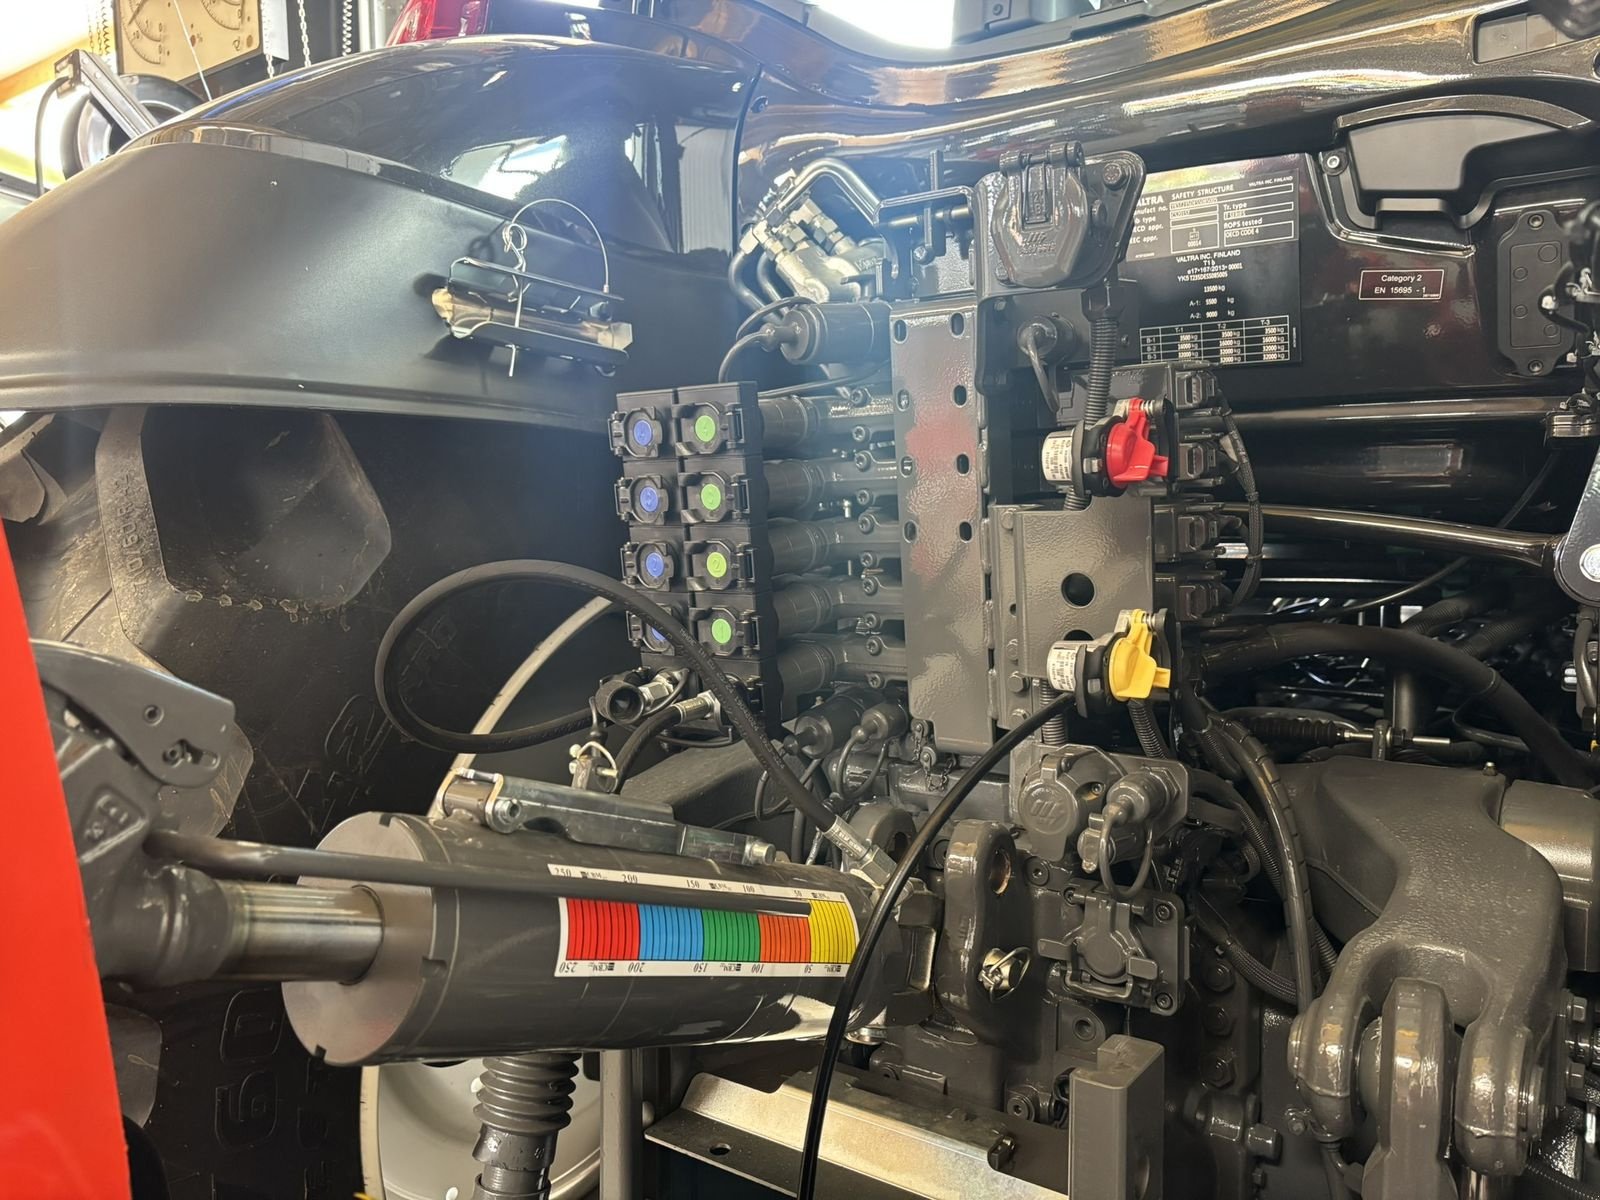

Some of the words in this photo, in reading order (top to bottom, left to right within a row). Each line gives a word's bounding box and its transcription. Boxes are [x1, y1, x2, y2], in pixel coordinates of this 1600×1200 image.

[1137, 195, 1164, 207] ALTRA
[1171, 190, 1195, 201] SAFETY
[1197, 184, 1234, 197] STRUCTURE
[1232, 202, 1248, 211] type
[1224, 220, 1240, 229] ROPS
[1242, 217, 1262, 226] tested
[1176, 254, 1199, 263] VALTRA
[1200, 252, 1212, 260] INC.
[1213, 249, 1241, 259] FINLAND
[1381, 274, 1415, 283] Category
[1374, 286, 1386, 294] EN
[1390, 286, 1412, 294] 15695
[622, 873, 638, 884] 200
[686, 879, 700, 889] 150
[742, 884, 755, 893] 100
[794, 889, 802, 898] 50
[559, 962, 578, 973] 250
[627, 962, 645, 973] 200
[693, 962, 708, 973] 150
[752, 963, 765, 974] 100
[804, 964, 813, 974] 50
